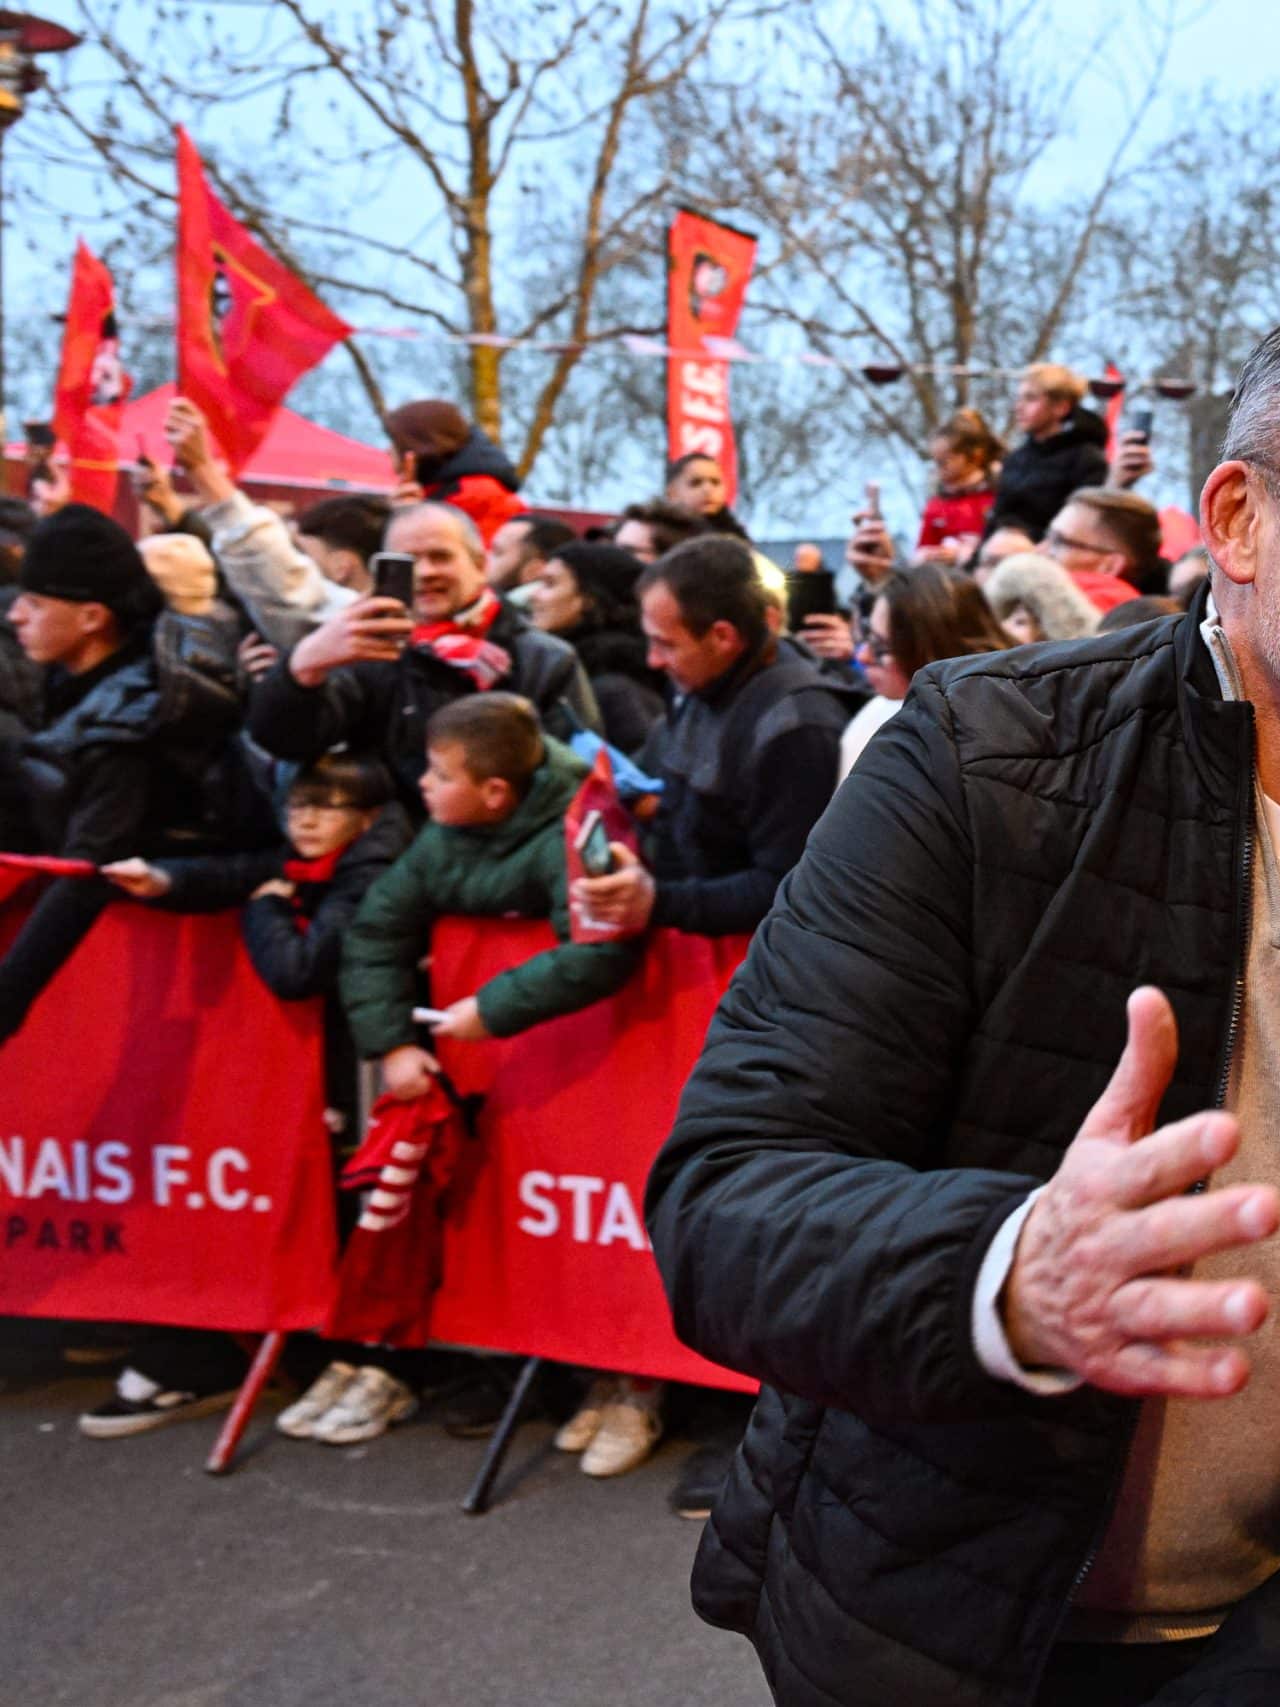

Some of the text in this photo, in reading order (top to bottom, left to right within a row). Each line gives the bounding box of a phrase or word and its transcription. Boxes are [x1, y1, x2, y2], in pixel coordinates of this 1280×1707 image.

[153, 1144, 272, 1213] F.C.
[518, 1169, 655, 1251] STA
[5, 1215, 127, 1254] PARK
